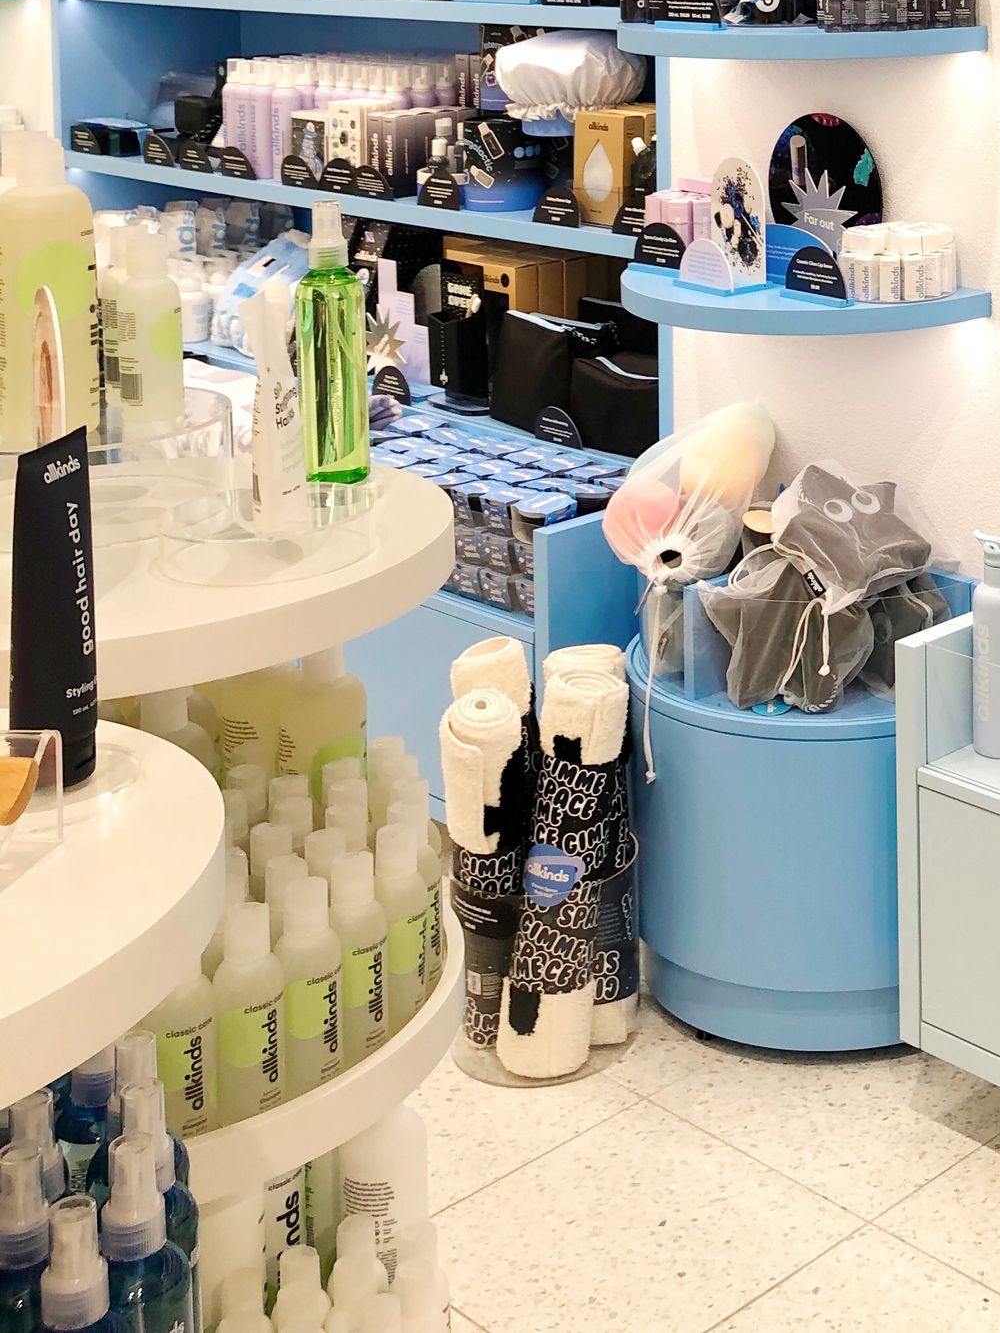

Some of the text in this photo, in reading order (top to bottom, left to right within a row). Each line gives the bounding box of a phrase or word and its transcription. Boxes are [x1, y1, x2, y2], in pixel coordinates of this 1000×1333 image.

[803, 212, 836, 232] Far out
[892, 265, 900, 301] allkinds
[42, 454, 81, 485] allkinds
[66, 500, 94, 657] good hair day
[65, 680, 94, 699] Styling
[975, 622, 990, 723] allkinds
[543, 750, 607, 796] GIMME
[537, 770, 598, 821] SPACE
[527, 861, 571, 884] allkinds
[352, 941, 379, 957] classic
[306, 971, 333, 987] classic
[368, 950, 383, 1023] allkinds
[243, 1000, 273, 1015] classic
[323, 980, 338, 1054] allkinds
[165, 1026, 197, 1040] classic
[261, 1008, 278, 1084] allkinds
[183, 1035, 203, 1111] allkinds
